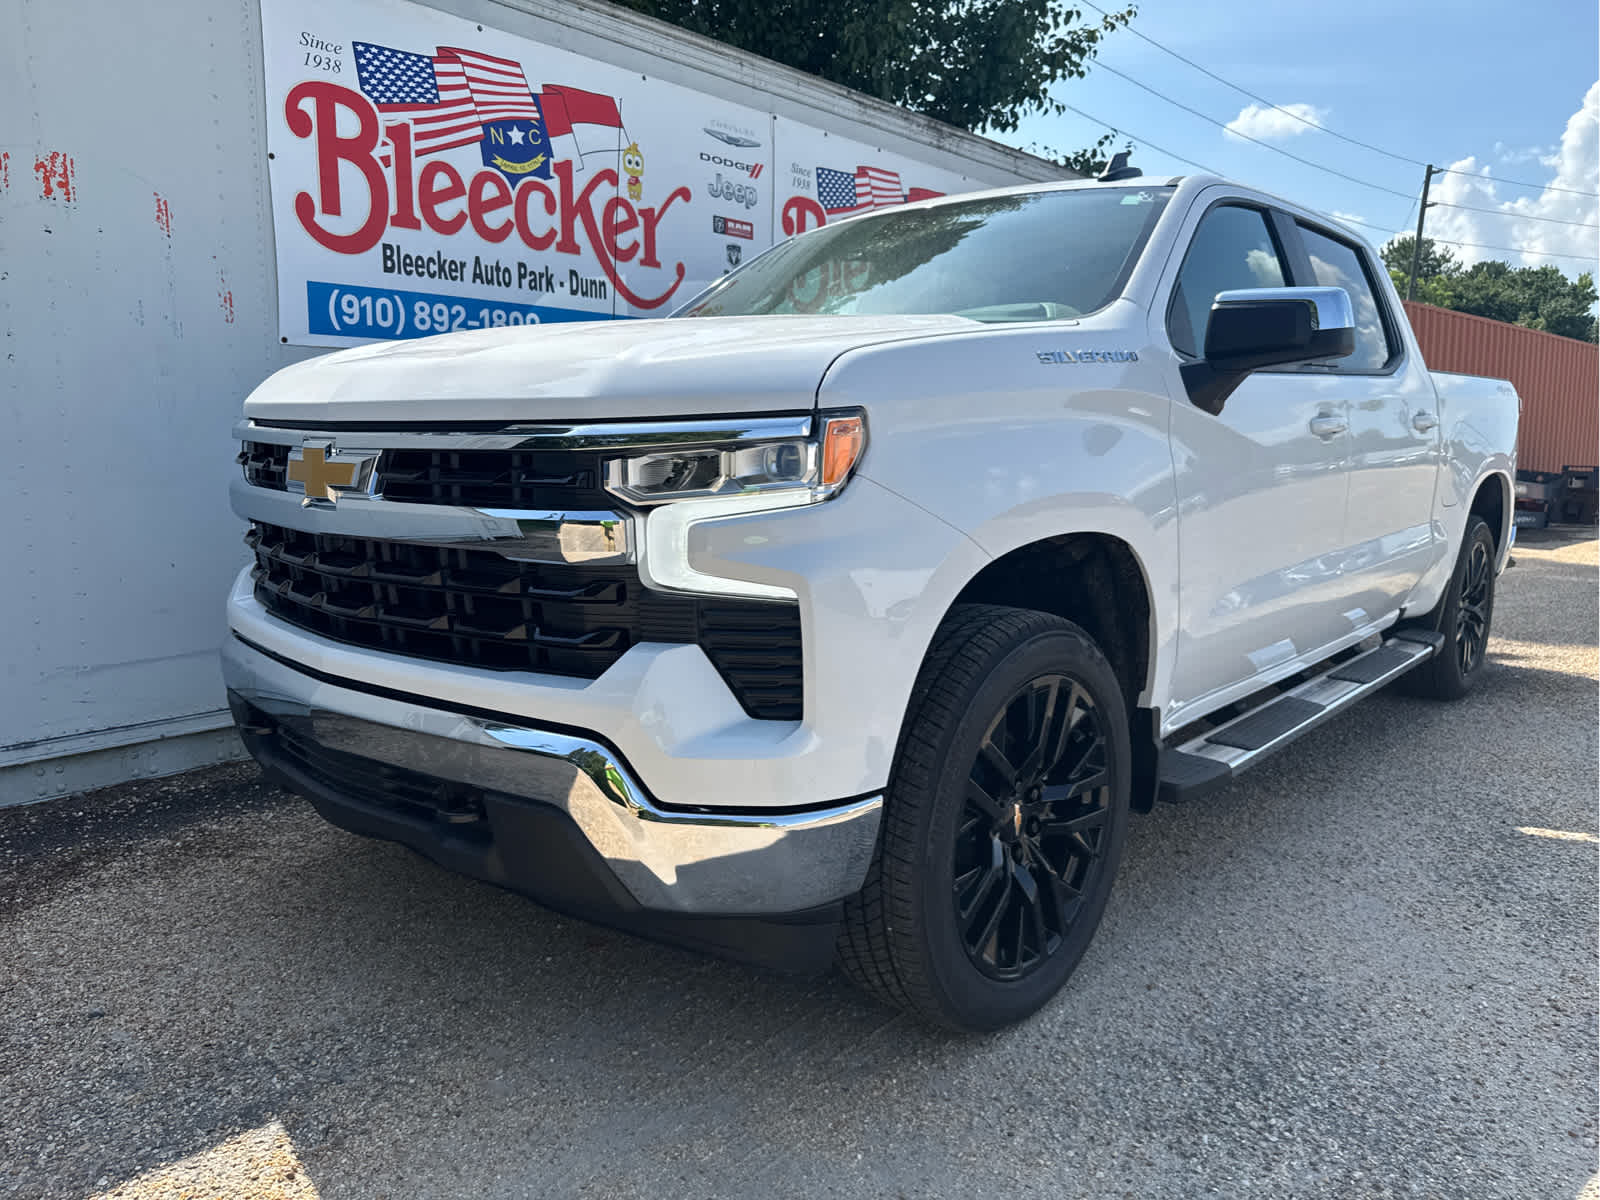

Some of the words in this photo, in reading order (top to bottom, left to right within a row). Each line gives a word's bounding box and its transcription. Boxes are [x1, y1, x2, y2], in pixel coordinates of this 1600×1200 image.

[299, 31, 343, 55] Since
[303, 52, 342, 74] 1938
[490, 127, 504, 145] N
[700, 152, 754, 173] DODGE
[285, 81, 692, 310] Bleecker
[707, 173, 758, 210] Jeep
[382, 243, 467, 283] Bleecker
[472, 255, 513, 288] Auto
[517, 262, 555, 293] Park
[569, 269, 607, 300] Dunn
[328, 289, 406, 335] (910)
[1036, 350, 1139, 364] SILVERADO
